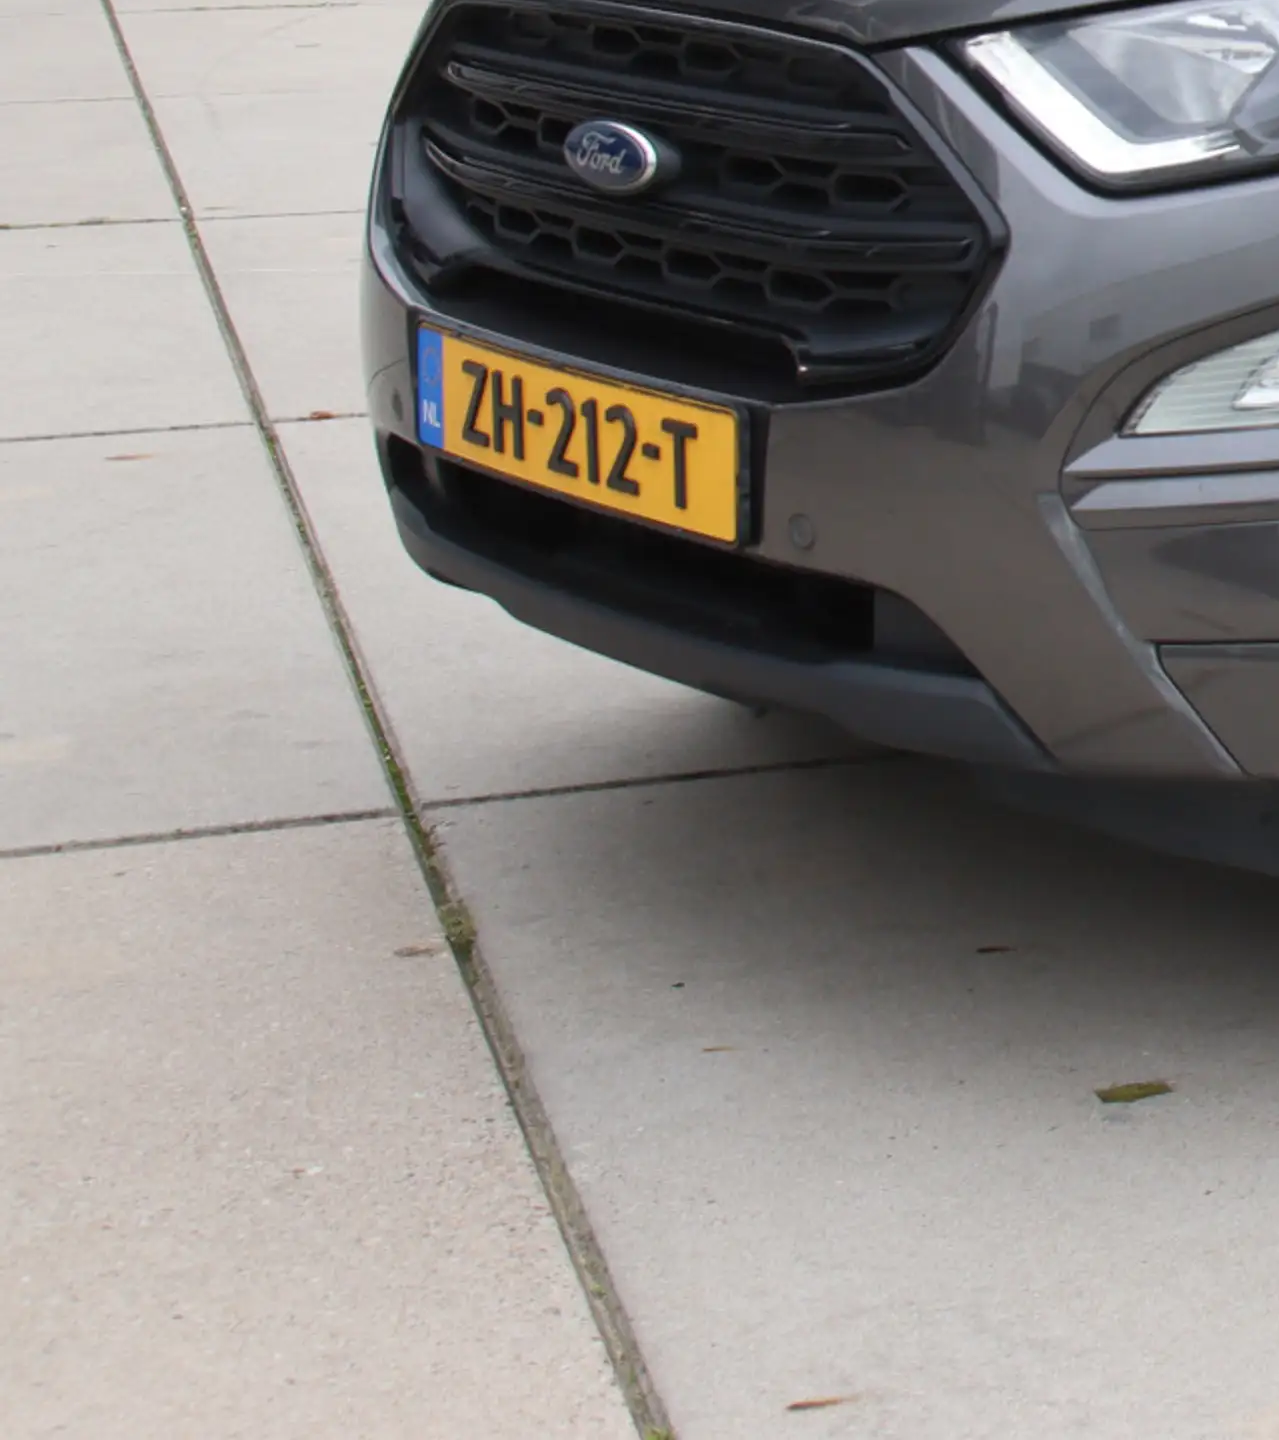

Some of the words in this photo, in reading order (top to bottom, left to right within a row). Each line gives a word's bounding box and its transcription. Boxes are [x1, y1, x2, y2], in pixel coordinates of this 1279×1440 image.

[576, 130, 627, 174] Ford
[422, 399, 441, 429] NL
[461, 359, 699, 510] ZH-212-T
